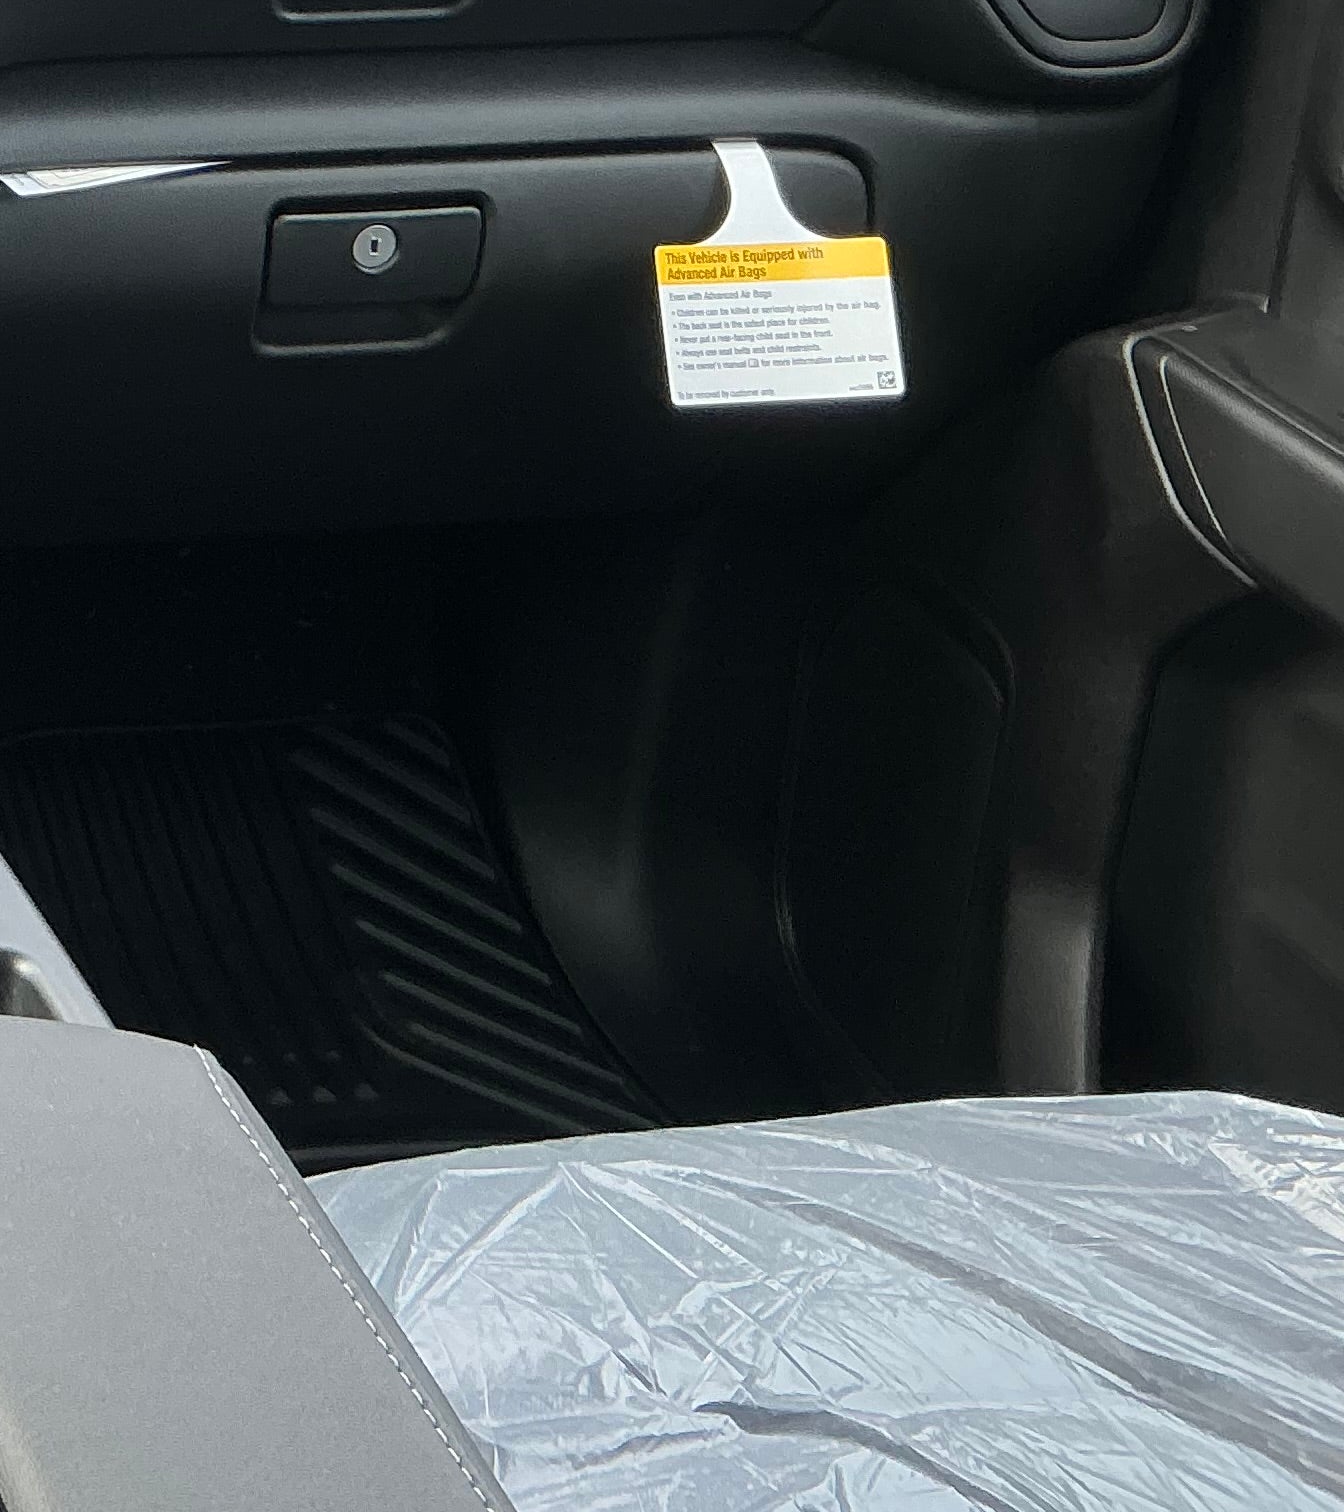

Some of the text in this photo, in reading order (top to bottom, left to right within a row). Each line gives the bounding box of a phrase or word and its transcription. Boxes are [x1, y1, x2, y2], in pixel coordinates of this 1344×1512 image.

[665, 252, 686, 264] This
[688, 252, 727, 264] Vehicle
[742, 248, 794, 264] Equipped
[798, 248, 824, 260] with
[668, 265, 766, 280] Advanced Air Bags
